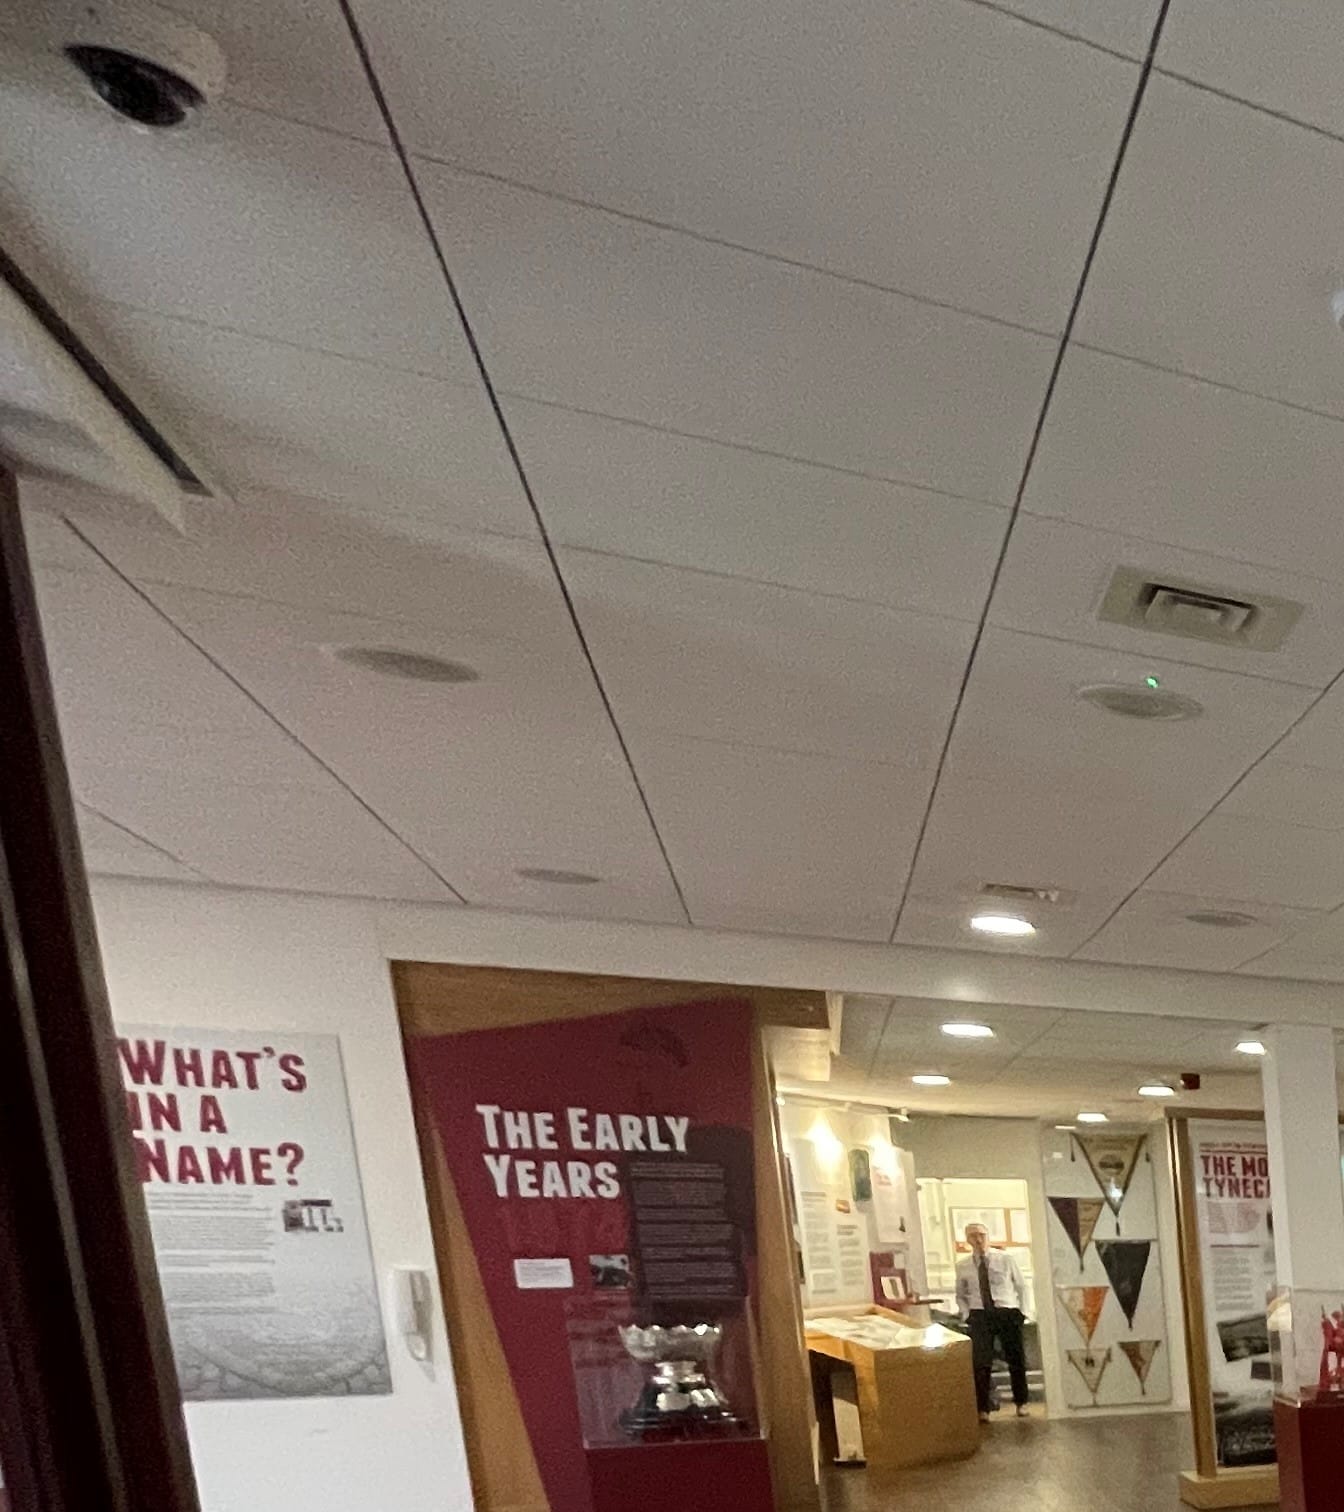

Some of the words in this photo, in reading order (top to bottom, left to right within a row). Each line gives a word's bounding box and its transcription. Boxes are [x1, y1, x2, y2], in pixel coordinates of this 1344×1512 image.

[116, 1038, 308, 1093] WHAT'S
[125, 1090, 182, 1133] IN
[199, 1094, 228, 1134] A
[475, 1103, 559, 1150] THE
[566, 1106, 689, 1154] EARLY
[134, 1137, 306, 1186] NAME?
[483, 1153, 622, 1199] YEARS
[1200, 1154, 1237, 1177] THE
